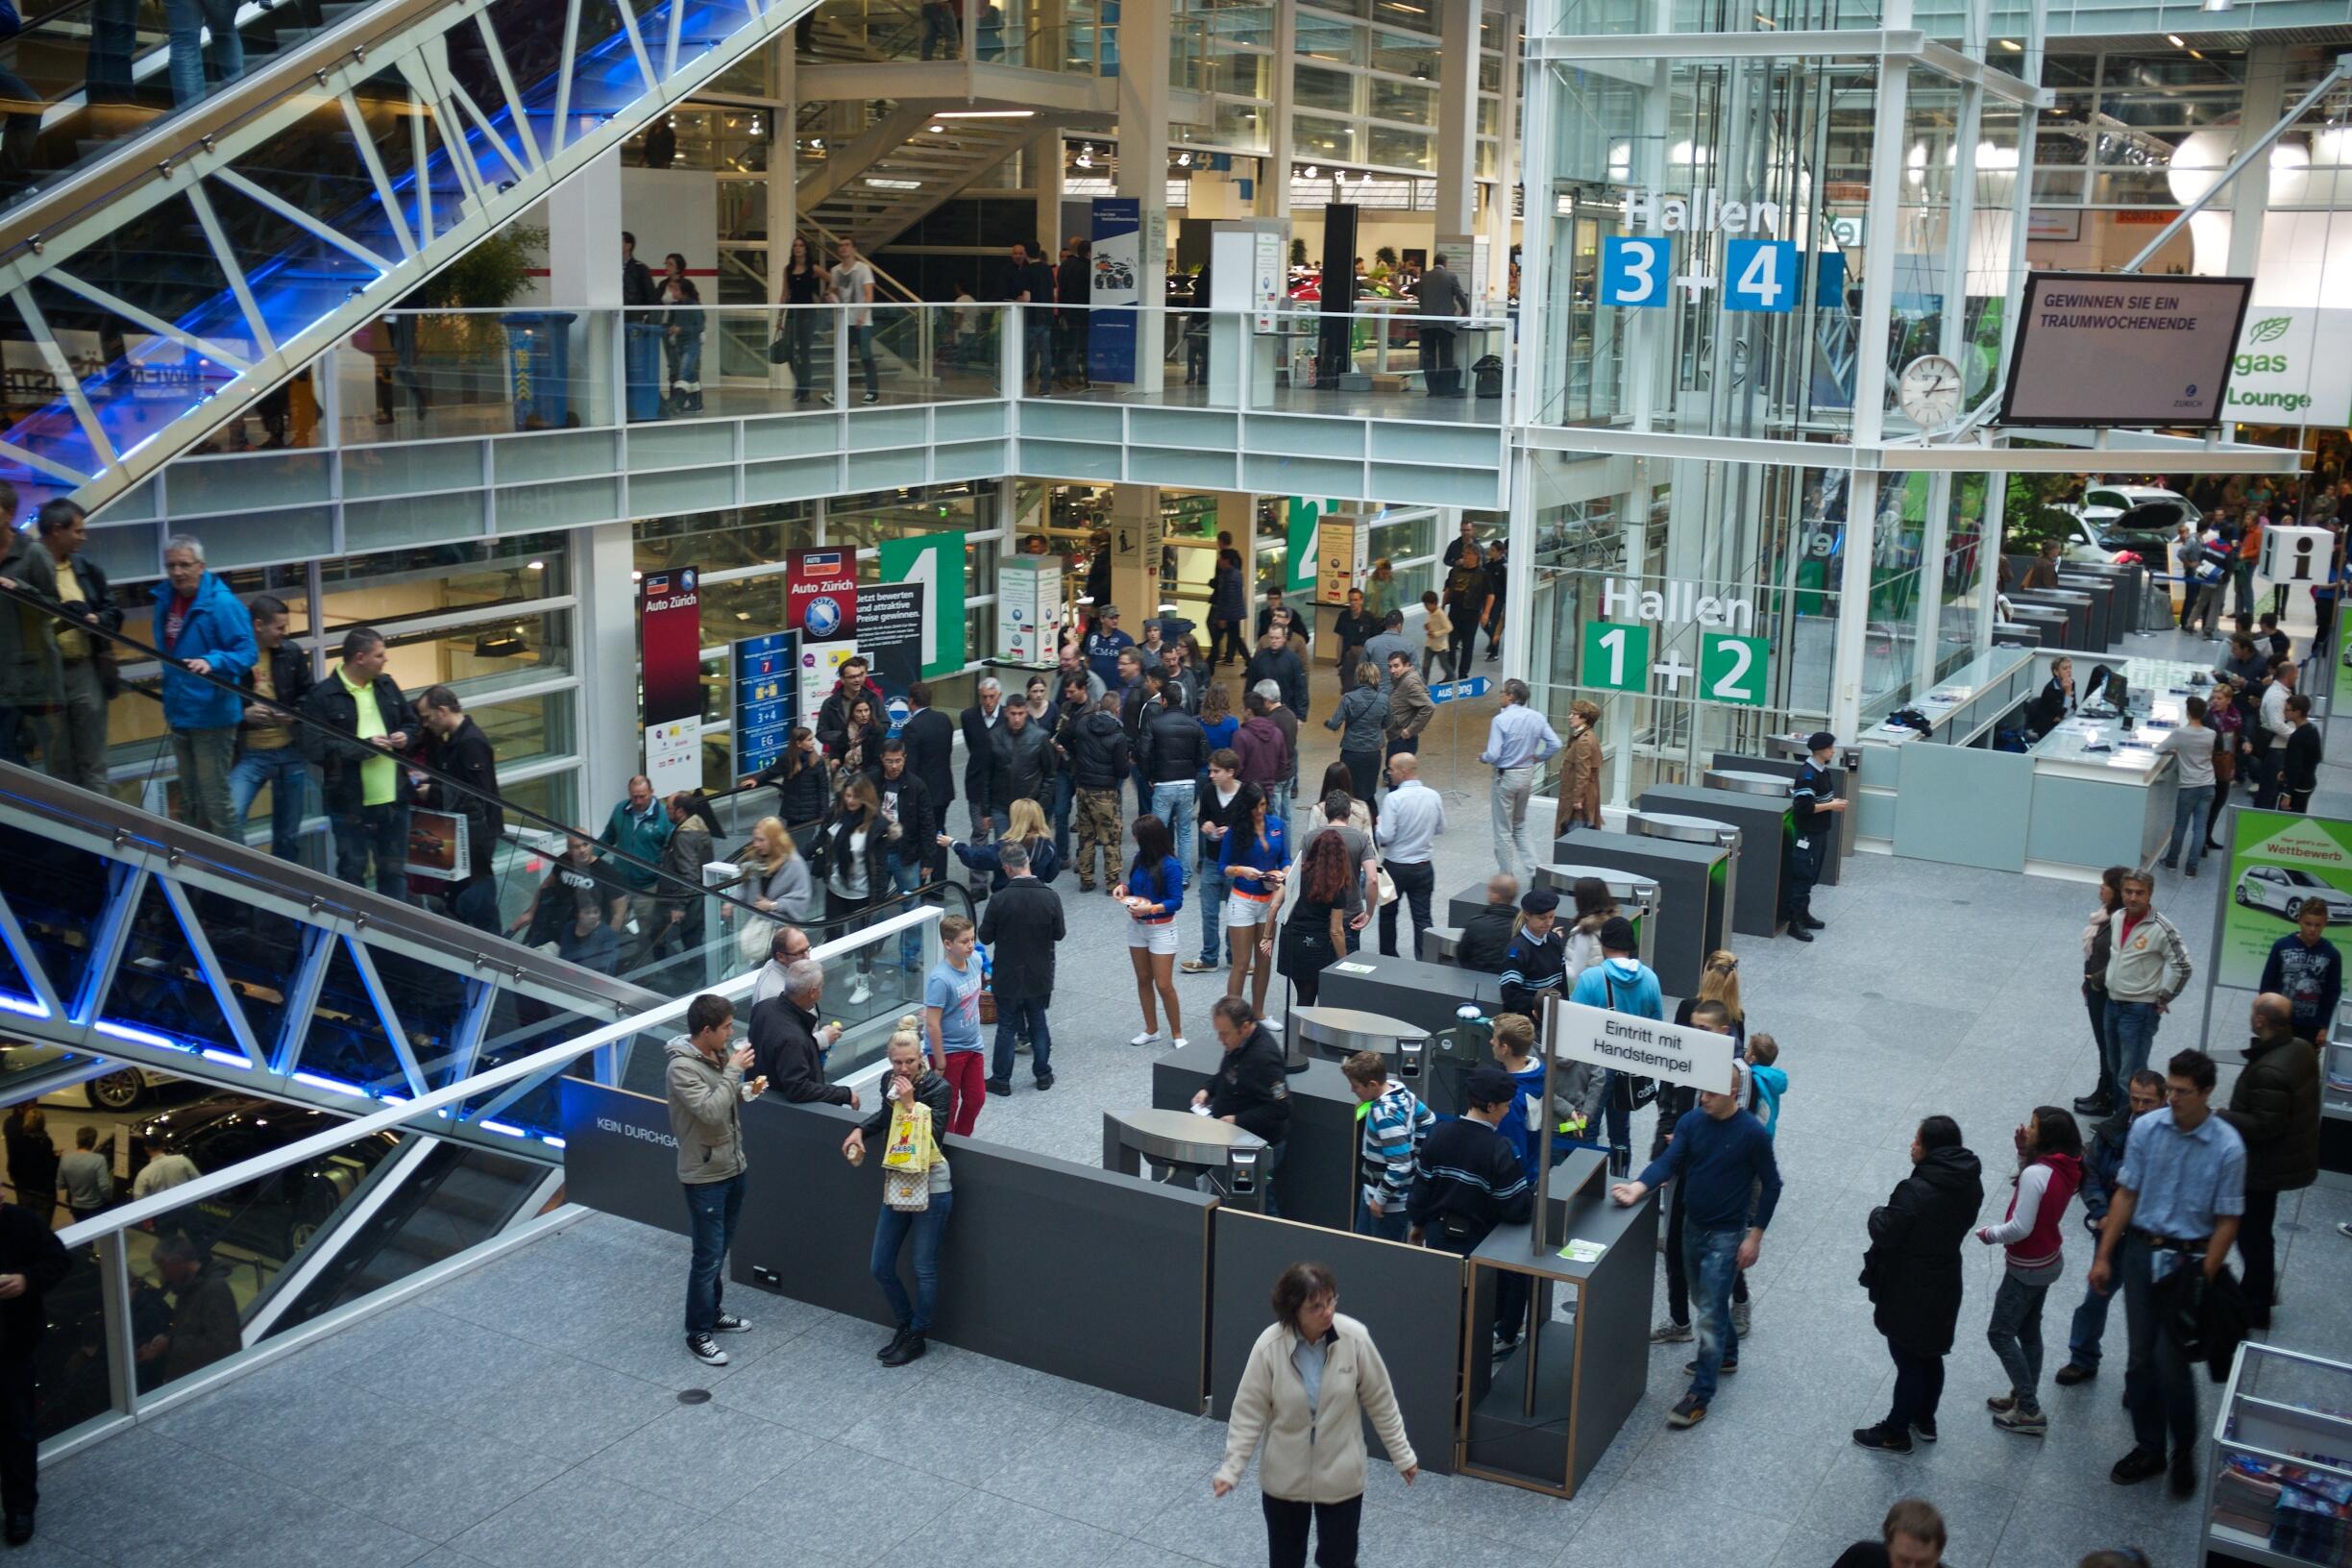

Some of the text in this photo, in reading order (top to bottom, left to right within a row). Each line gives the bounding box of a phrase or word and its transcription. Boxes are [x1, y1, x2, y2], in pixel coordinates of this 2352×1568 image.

[1625, 187, 1779, 233] Hallen
[1616, 241, 1654, 302] 3
[1737, 245, 1781, 306] 4
[2044, 293, 2179, 310] GEWINNEN SIE EIN
[2041, 314, 2197, 331] TRAUMWOCHENENDE
[2234, 354, 2288, 377] gas
[2228, 386, 2313, 411] Lounge
[2290, 536, 2314, 580] i
[791, 578, 853, 594] Auto Zürich
[876, 591, 914, 601] bewerten
[646, 593, 697, 612] Auto Zürich
[873, 600, 911, 612] attraktive
[1604, 577, 1753, 629] Hallen
[1599, 628, 1626, 685] 1
[1712, 639, 1752, 699] 2
[2266, 843, 2342, 861] Wettbewerb
[1605, 1019, 1683, 1050] Eintritt mit
[1593, 1038, 1692, 1073] Handstempel
[597, 1116, 680, 1149] KEIN DURCHGA
